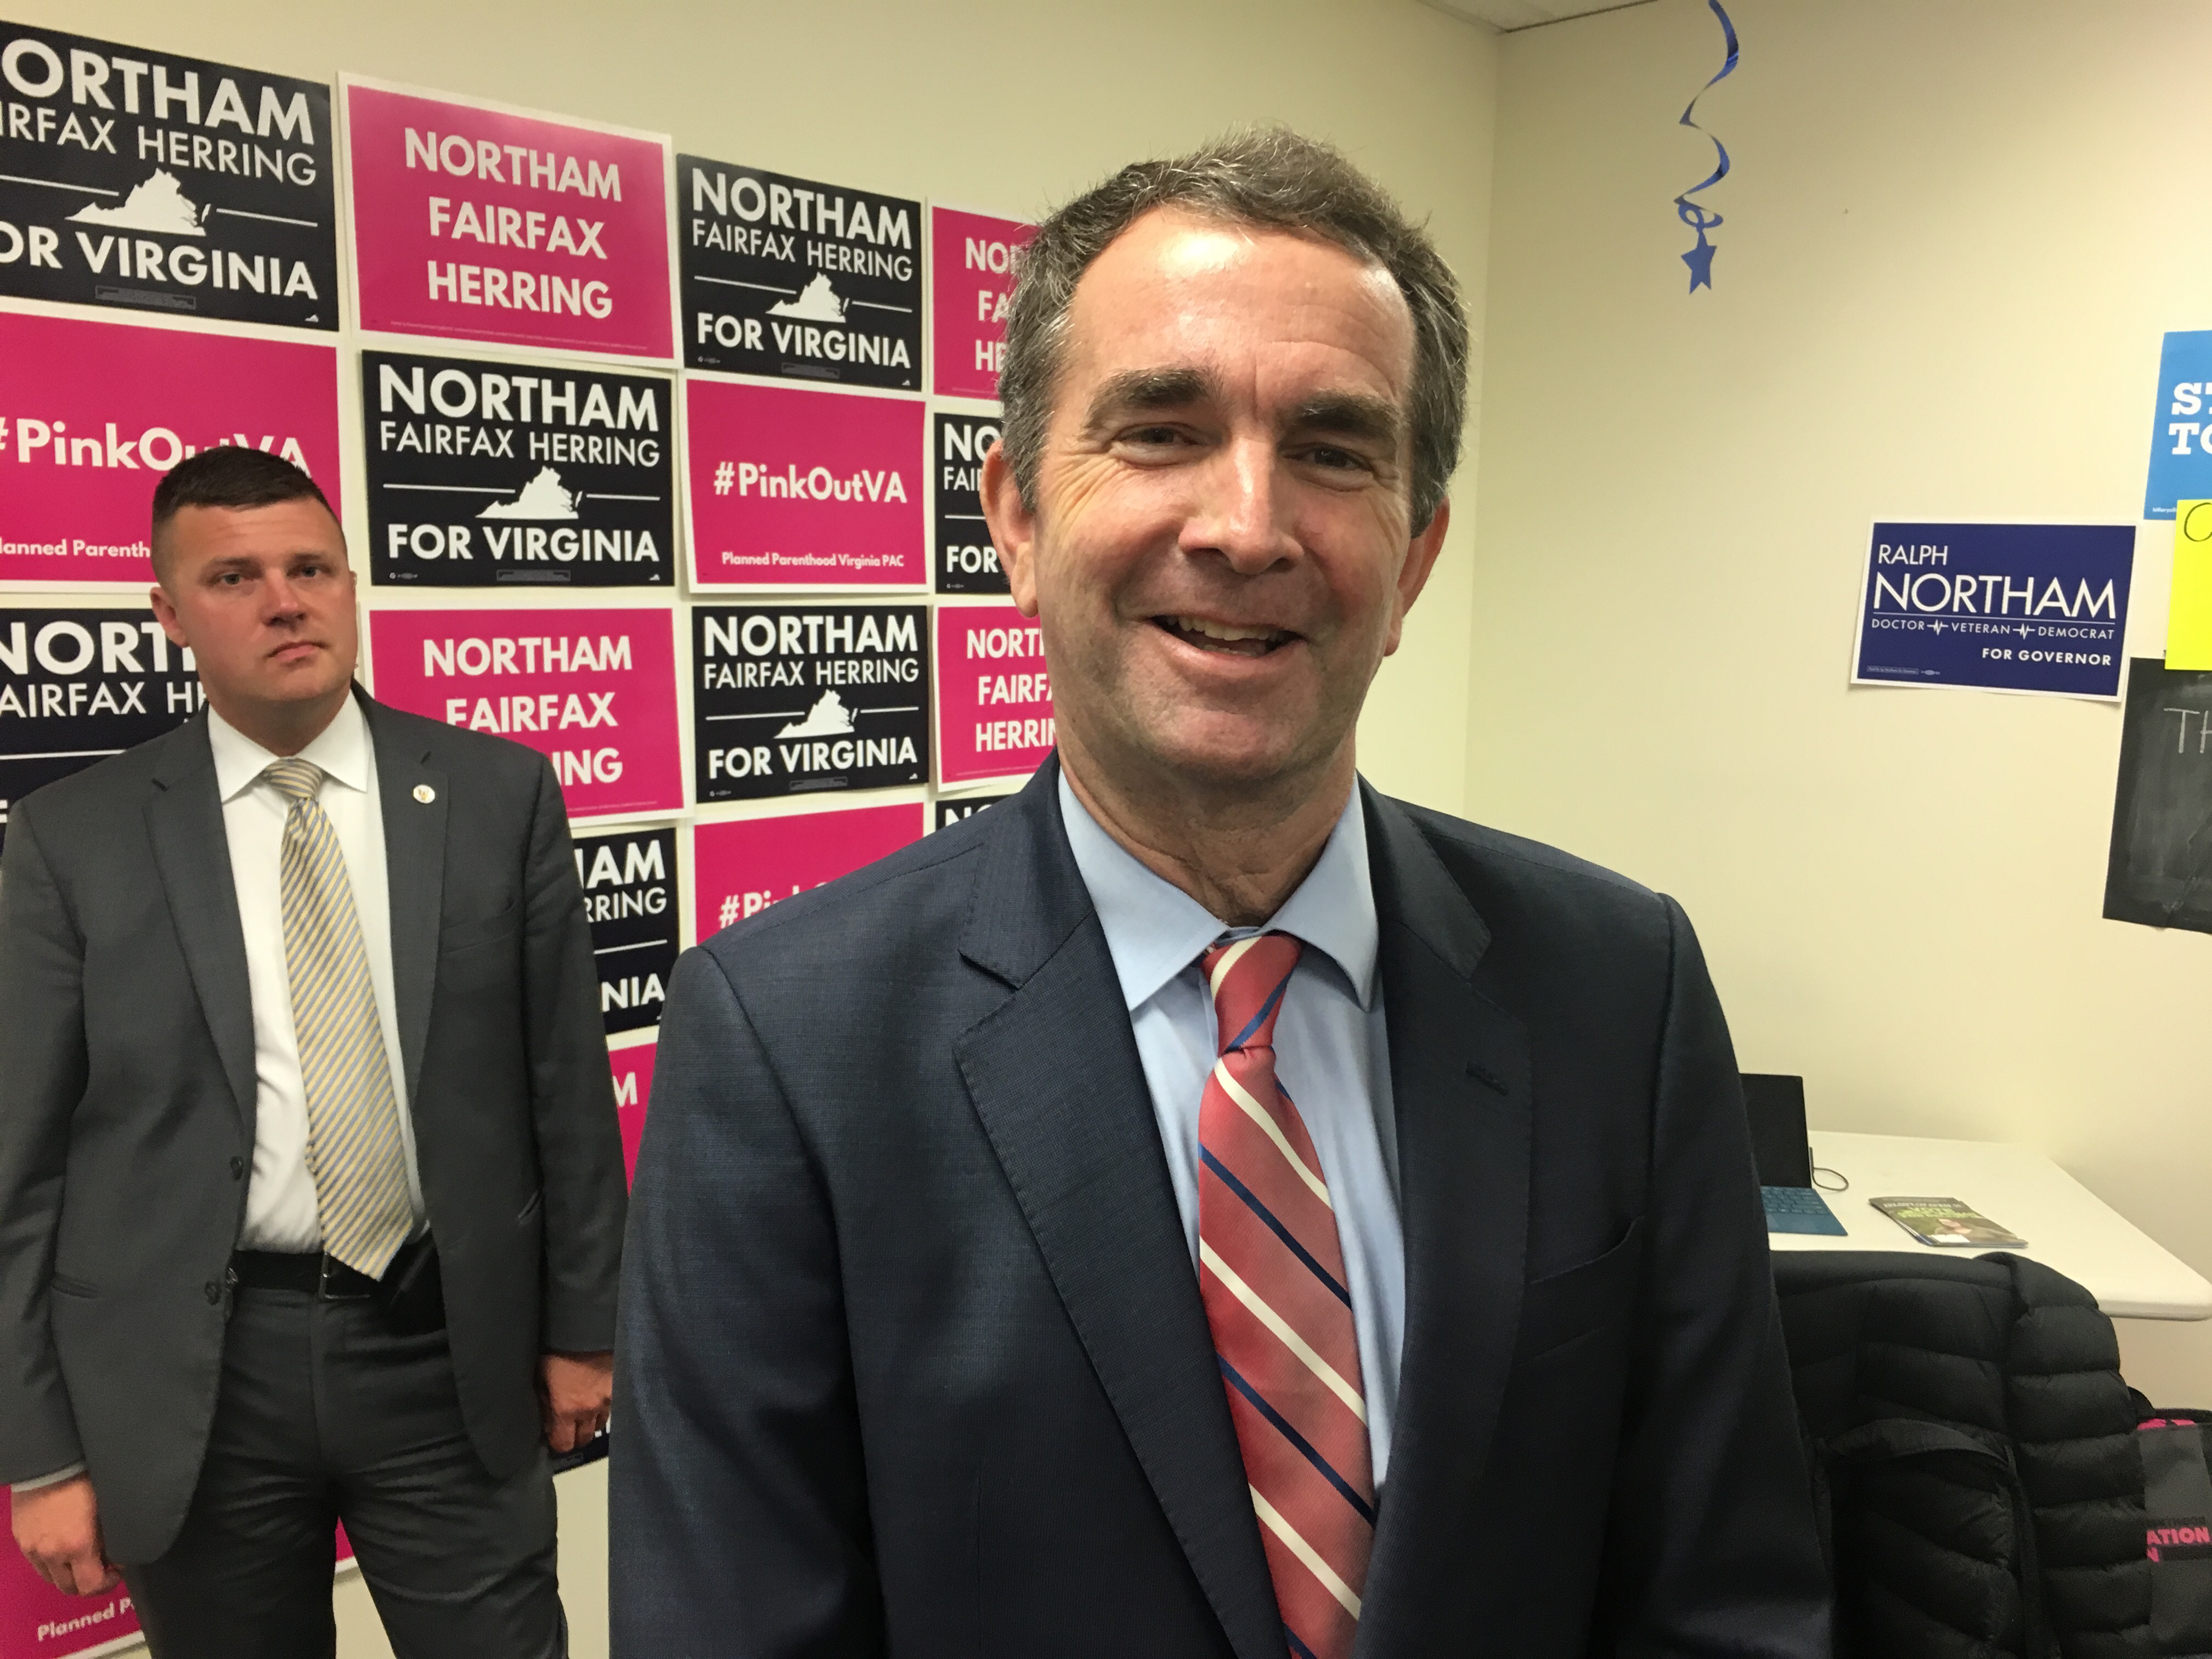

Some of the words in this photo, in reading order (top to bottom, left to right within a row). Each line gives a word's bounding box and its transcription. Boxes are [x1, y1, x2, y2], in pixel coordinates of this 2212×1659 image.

[2, 38, 314, 145] ORTHAM
[138, 126, 317, 186] HERRING
[405, 127, 622, 202] NORTHAM
[428, 196, 608, 260] FAIRFAX
[692, 168, 912, 249] NORTHAM
[75, 232, 318, 300] VIRGINIA
[693, 219, 796, 262] FAIRFAX
[807, 241, 912, 281] HERRING
[427, 261, 613, 319] HERRING
[697, 312, 765, 351] FOR
[771, 322, 911, 369] VIRGINIA
[379, 364, 659, 432] NORTHAM
[380, 421, 514, 459] FAIRFAX
[530, 432, 660, 467] HERRING
[714, 461, 908, 504] #PinkOutVA
[388, 523, 473, 560] FOR
[482, 527, 660, 563] VIRGINIA
[722, 551, 770, 566] Planned
[772, 552, 837, 567] Parenthood
[838, 554, 881, 569] Virginia
[882, 555, 904, 567] PAC
[946, 545, 999, 573] FOR
[1878, 544, 1948, 566] RALPH
[1873, 571, 2116, 619] NORTHAM
[703, 615, 918, 657] NORTHAM
[1871, 618, 1925, 631] DOCTOR
[1951, 622, 2010, 635] VETERAN
[2038, 626, 2114, 640] DEMOCRAT
[423, 635, 633, 677] NORTHAM
[704, 661, 805, 690] FAIRFAX
[815, 658, 919, 685] HERRING
[1982, 648, 2012, 660] FOR
[2018, 650, 2111, 666] GOVERNOR
[446, 692, 618, 733] FAIRFAX
[708, 746, 772, 779] FOR
[780, 736, 918, 773] VIRGINIA
[574, 839, 665, 889] AM
[38, 1601, 115, 1642] Planned
